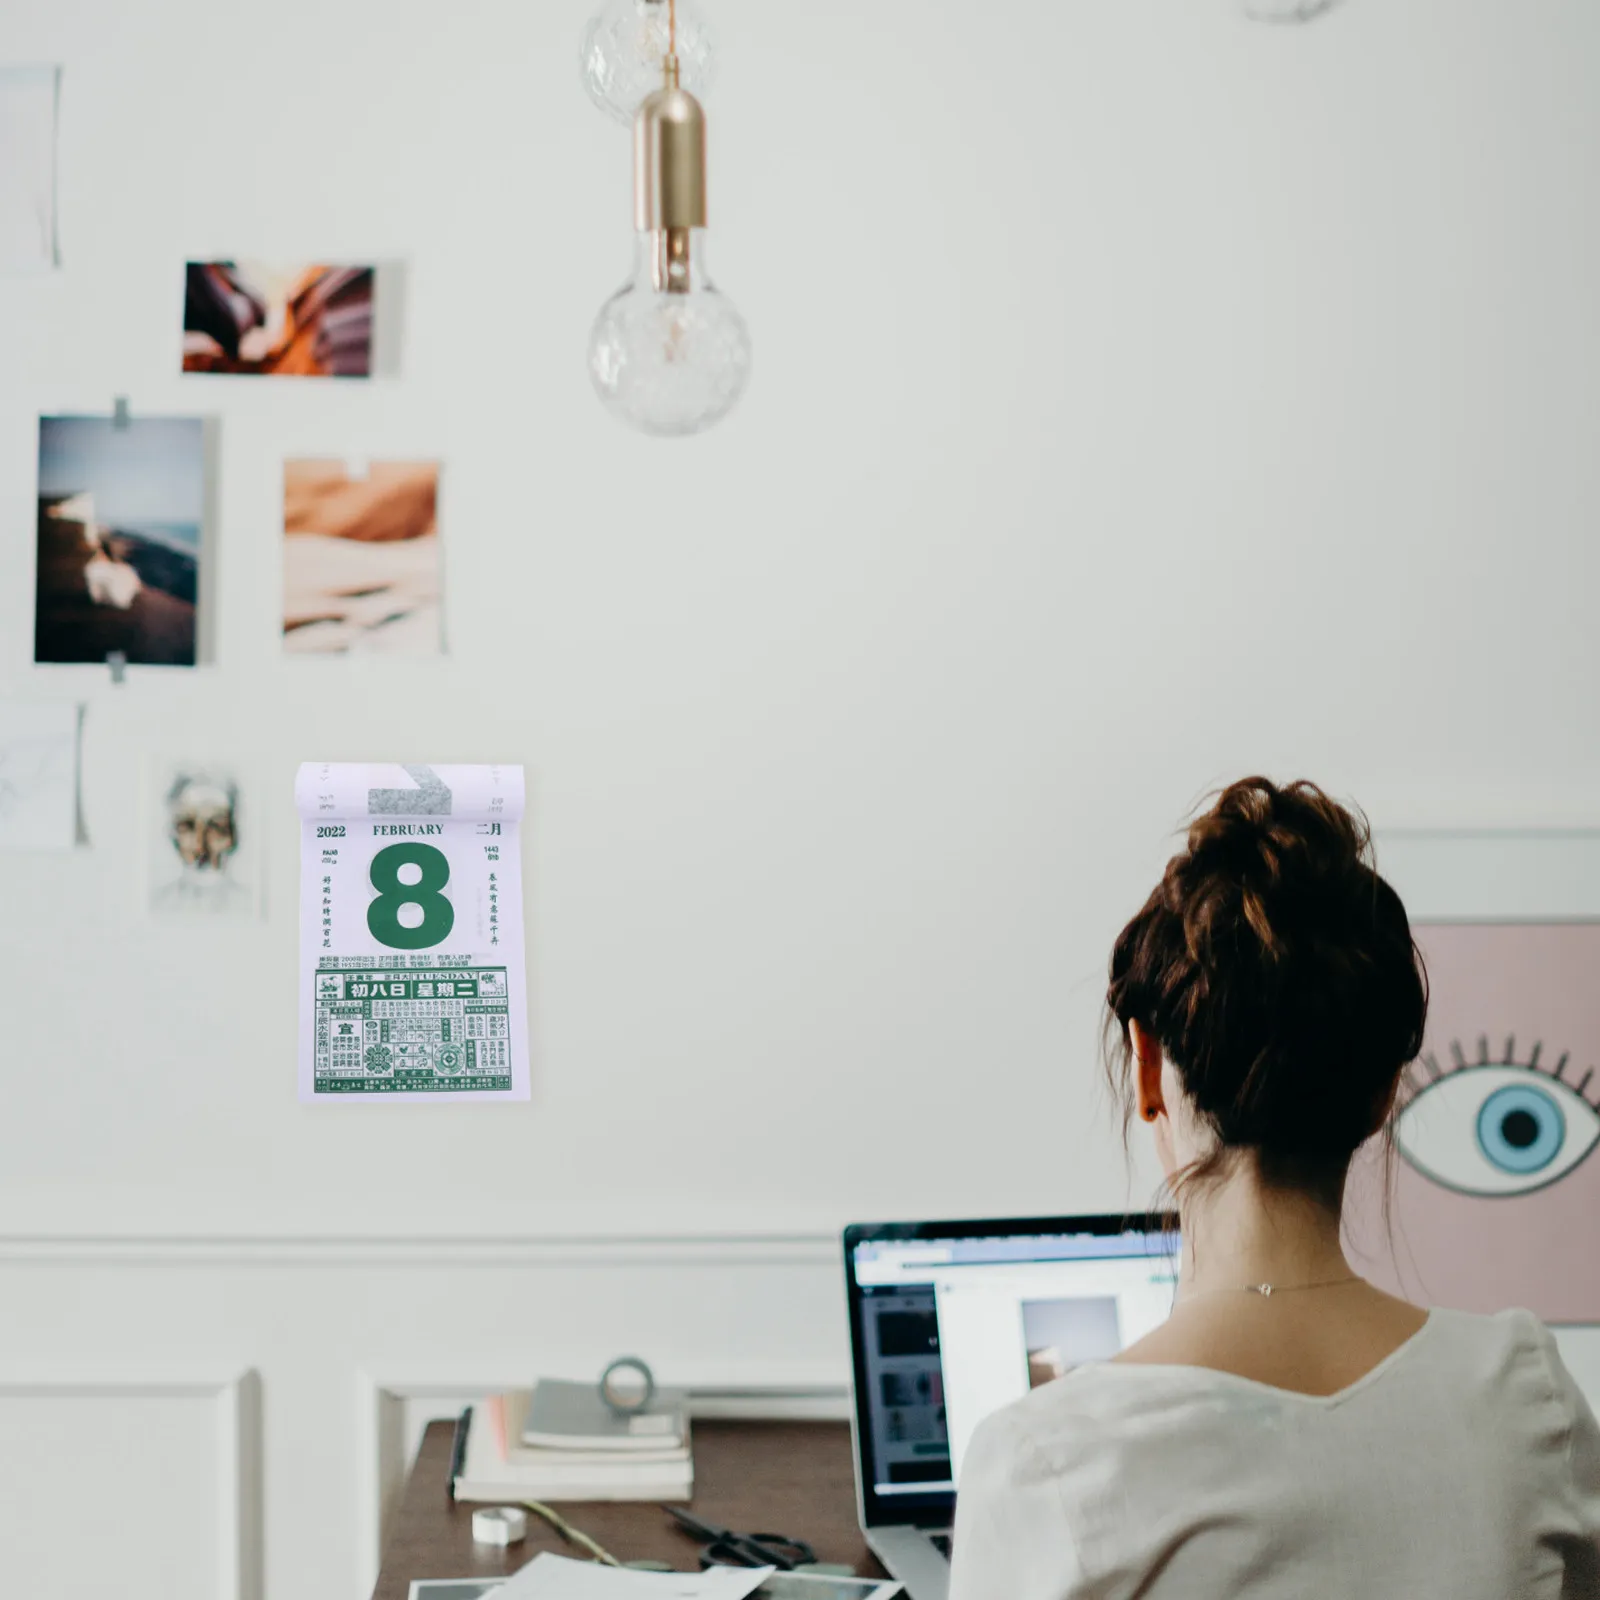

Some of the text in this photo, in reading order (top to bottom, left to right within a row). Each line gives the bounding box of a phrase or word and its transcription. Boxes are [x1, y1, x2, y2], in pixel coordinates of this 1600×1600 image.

[316, 822, 501, 838] 2022 FEBRUARY 二月
[367, 842, 454, 950] 8
[414, 972, 474, 980] TUESDAY
[351, 983, 406, 997] 初八日
[417, 982, 475, 997] 星期二
